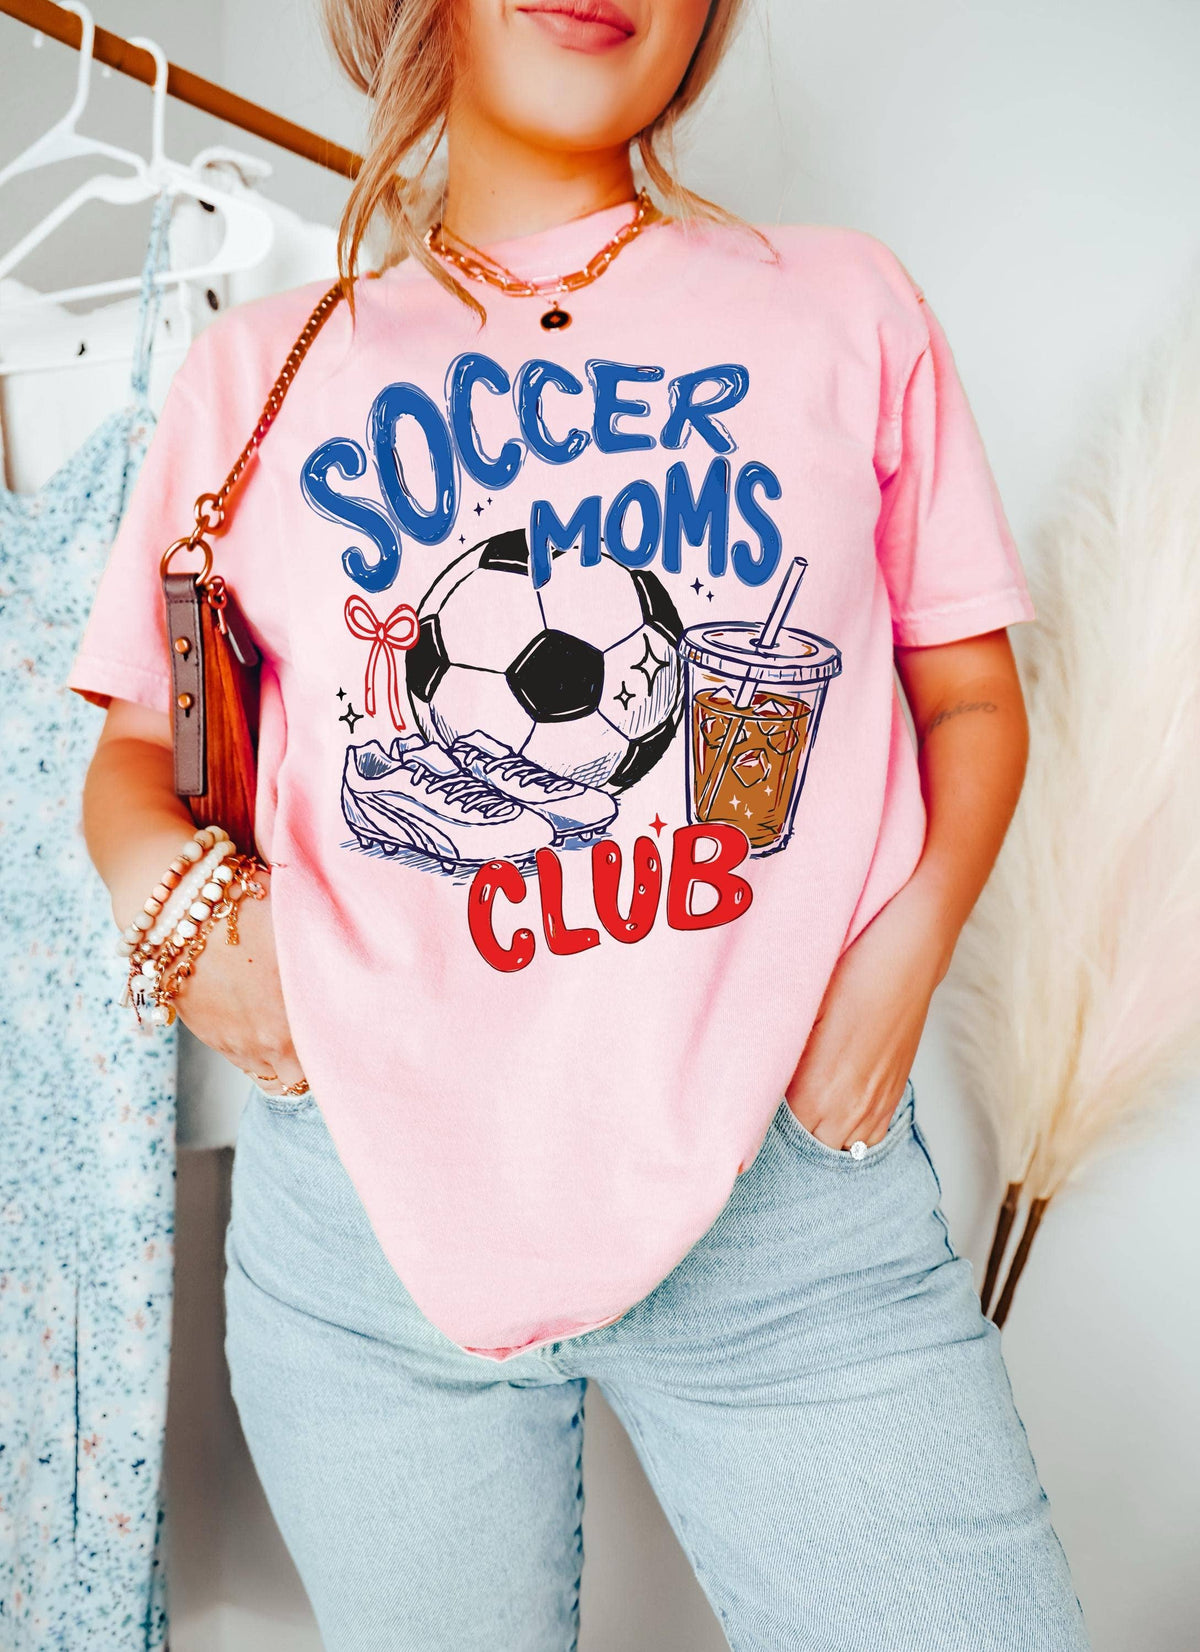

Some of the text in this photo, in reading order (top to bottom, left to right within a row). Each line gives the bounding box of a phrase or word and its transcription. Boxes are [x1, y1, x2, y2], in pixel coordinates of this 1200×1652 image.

[300, 353, 750, 593] SOCCER
[529, 457, 783, 588] MOMS
[467, 823, 754, 973] CLUB
